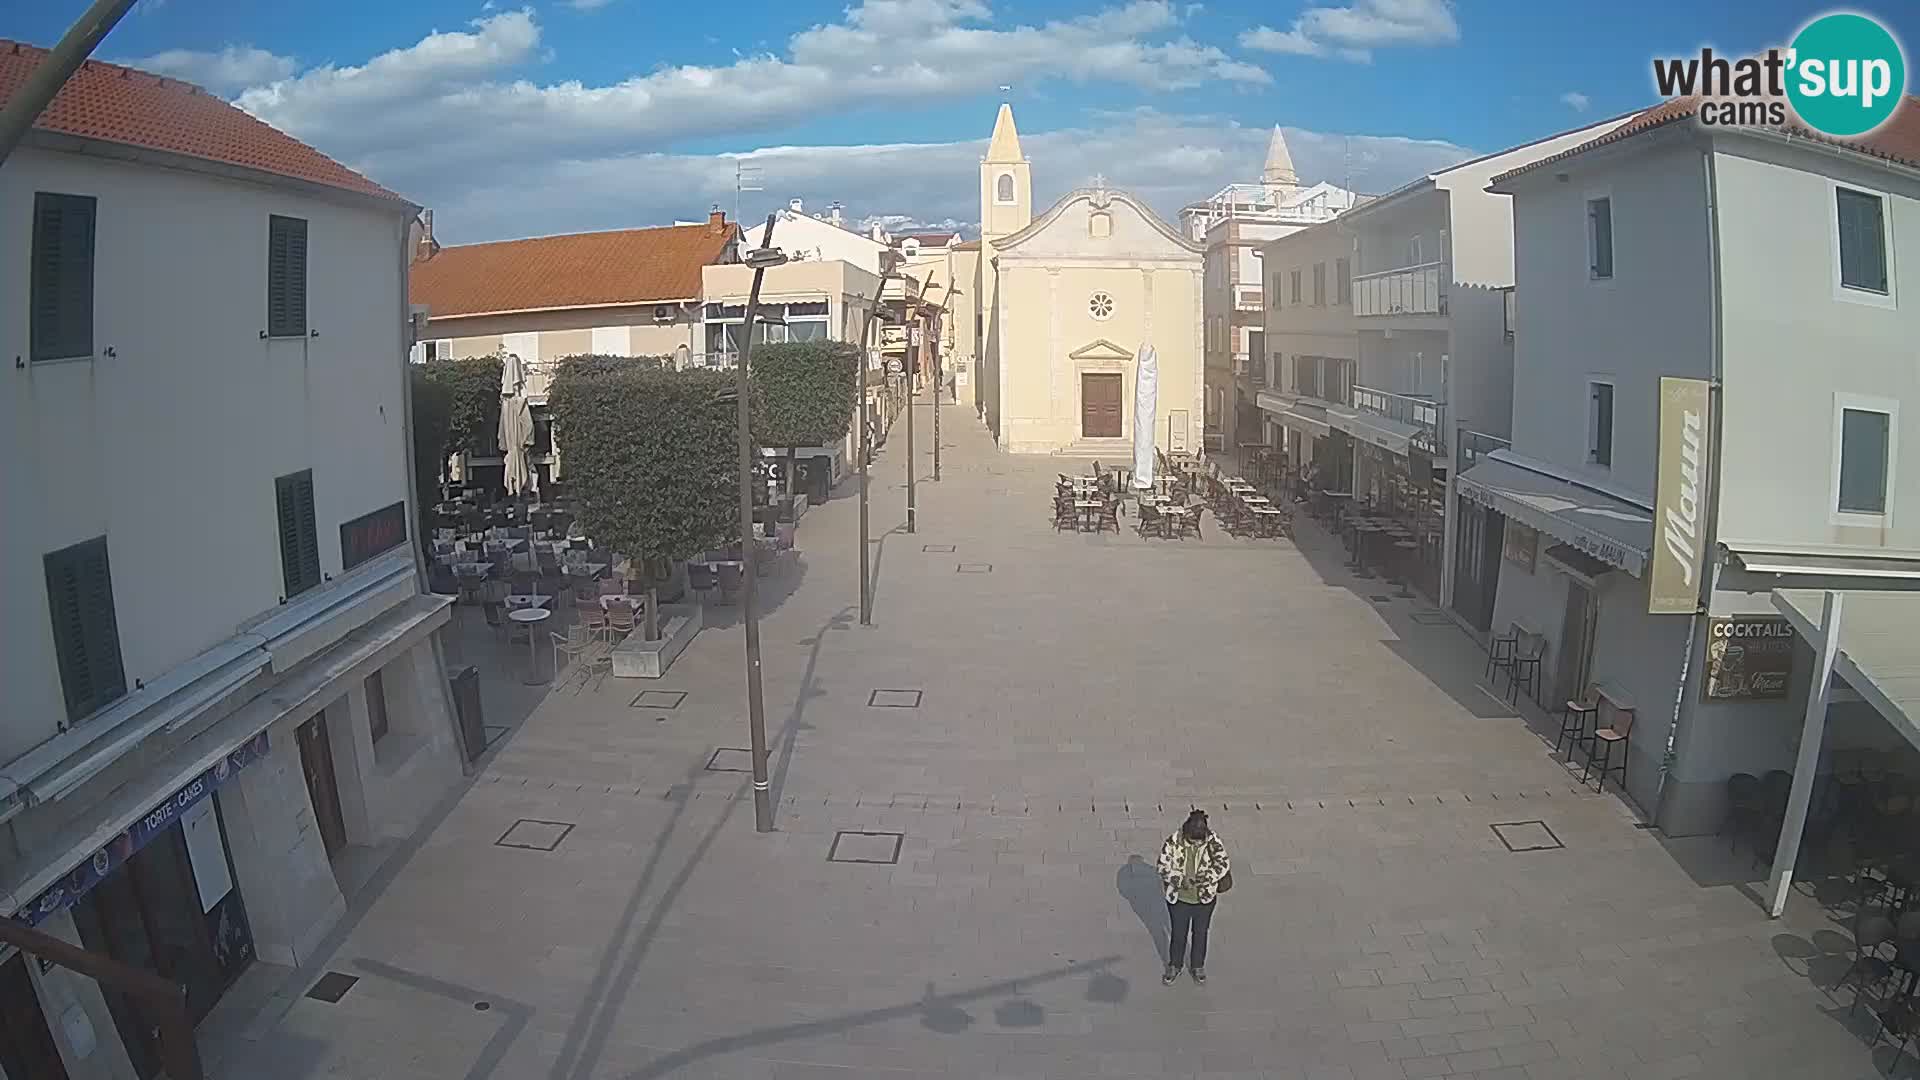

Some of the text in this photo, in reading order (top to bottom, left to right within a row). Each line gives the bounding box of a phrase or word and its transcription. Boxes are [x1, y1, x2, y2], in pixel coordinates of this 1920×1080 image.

[1713, 622, 1793, 637] COCKTAILS
[144, 802, 173, 831] TORTE
[178, 779, 203, 807] CAKES
